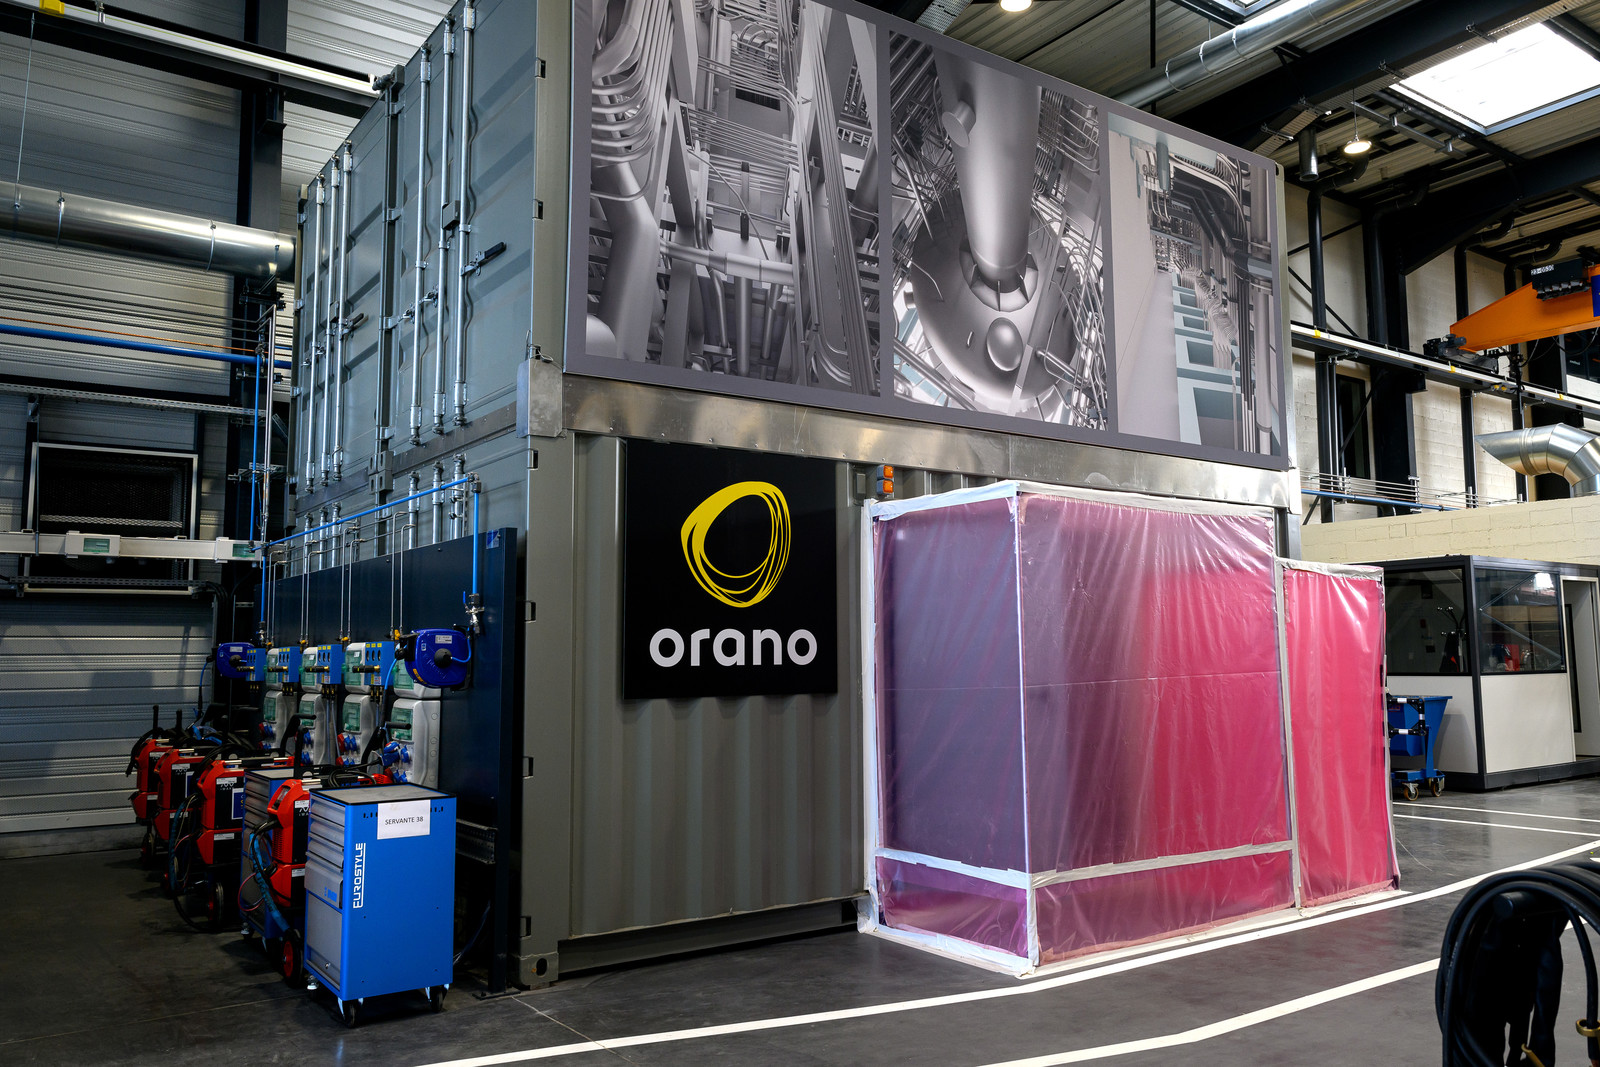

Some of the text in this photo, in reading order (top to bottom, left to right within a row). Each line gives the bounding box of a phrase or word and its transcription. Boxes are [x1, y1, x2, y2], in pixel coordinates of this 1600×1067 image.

[649, 628, 818, 667] orano
[385, 817, 415, 825] SERVANTE
[353, 842, 366, 909] EUROSTYLE
